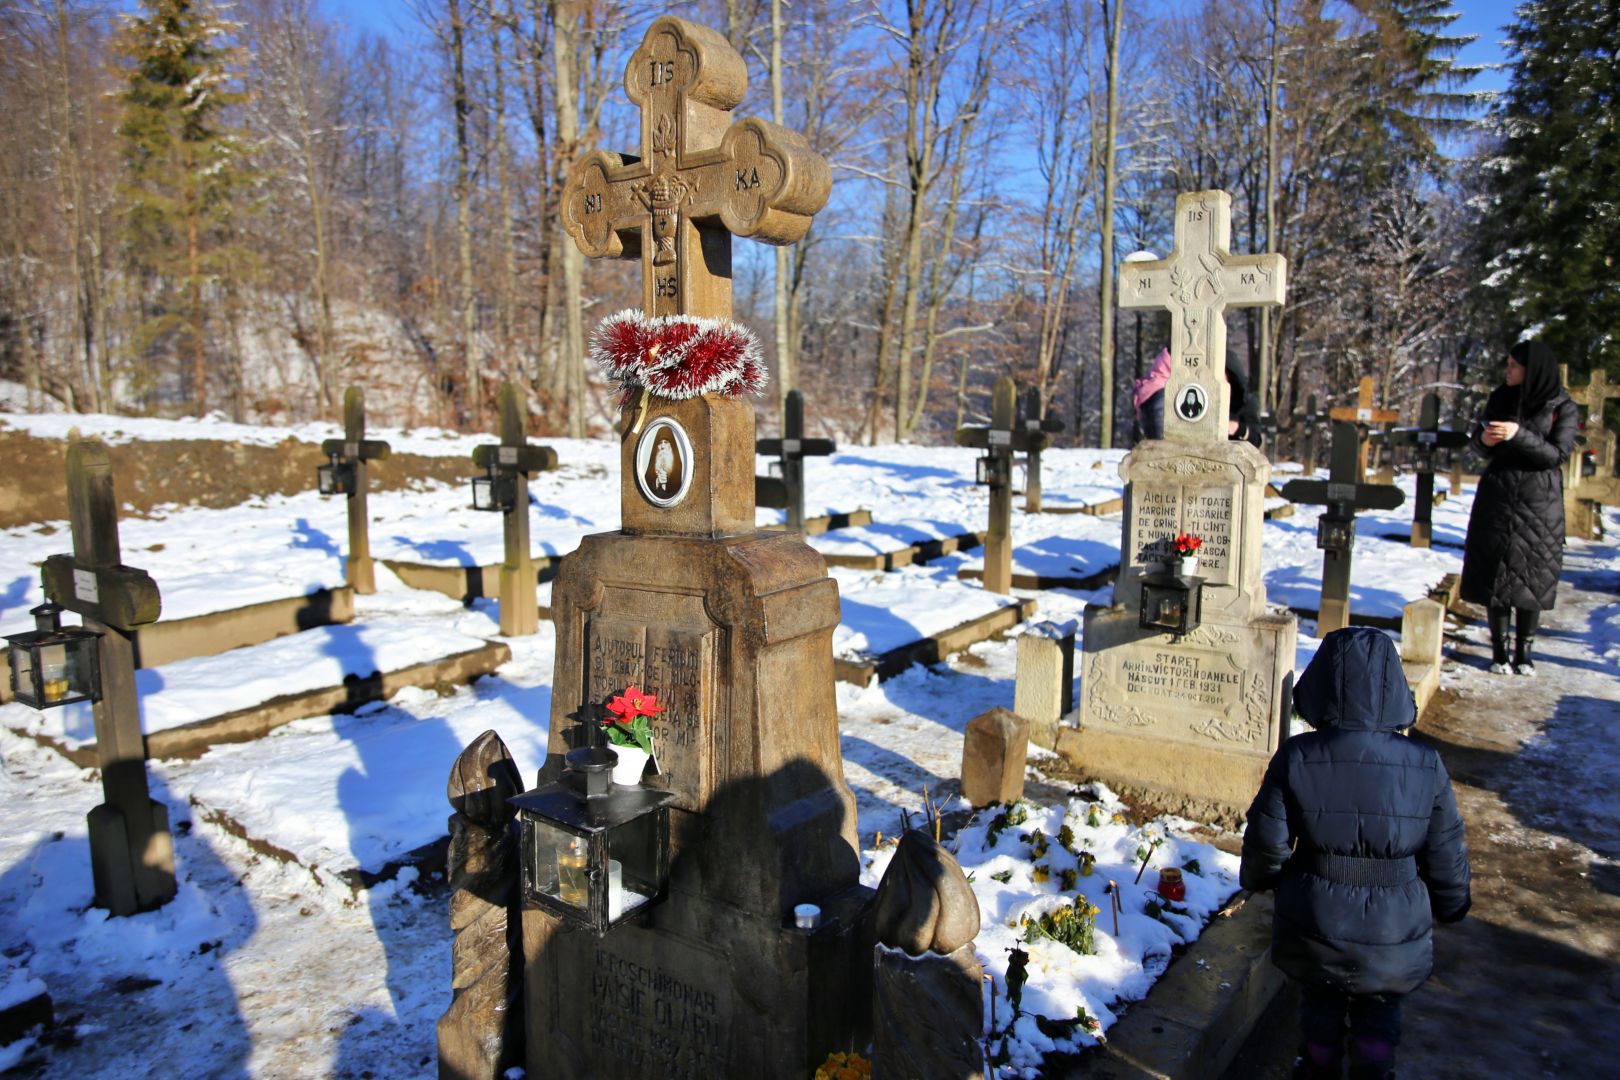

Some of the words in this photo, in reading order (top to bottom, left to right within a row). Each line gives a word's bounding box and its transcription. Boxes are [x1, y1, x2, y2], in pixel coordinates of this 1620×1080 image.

[735, 167, 760, 191] KA
[1241, 273, 1256, 285] KA
[1201, 497, 1230, 507] TOATE
[1138, 518, 1150, 527] DE
[1138, 529, 1144, 538] E
[653, 726, 669, 742] OR
